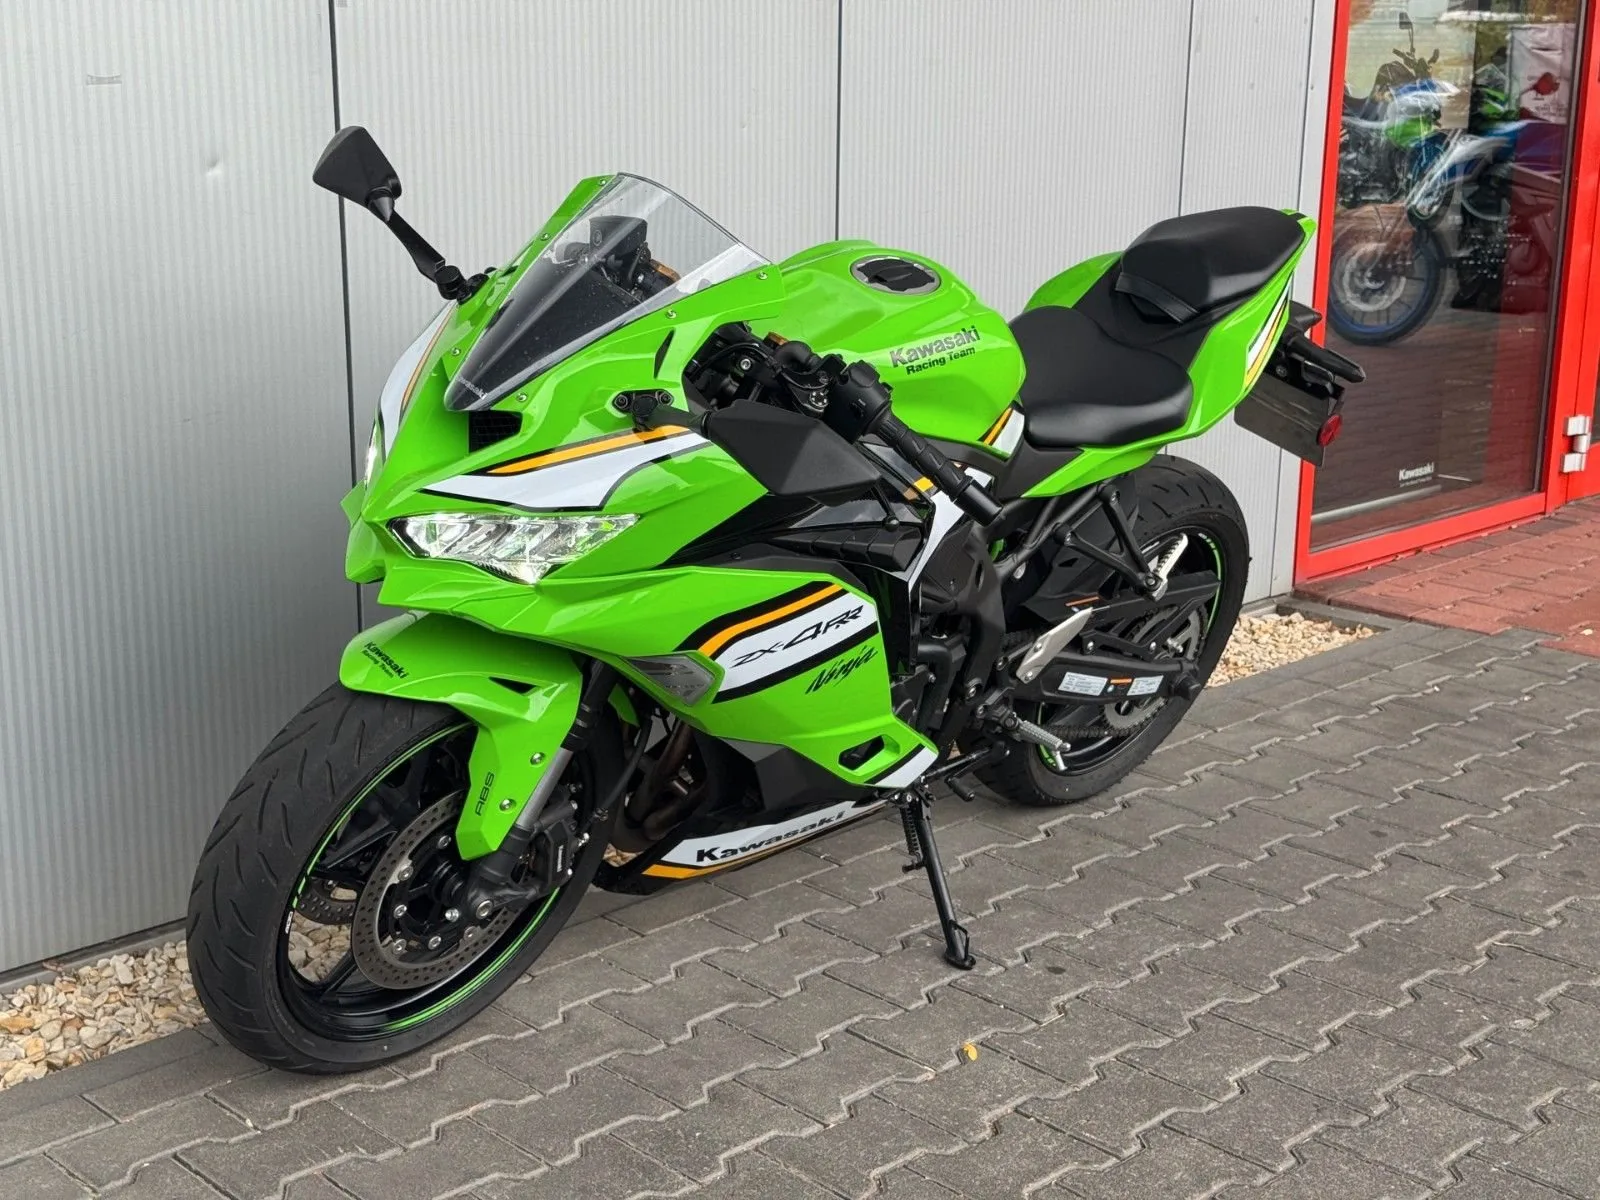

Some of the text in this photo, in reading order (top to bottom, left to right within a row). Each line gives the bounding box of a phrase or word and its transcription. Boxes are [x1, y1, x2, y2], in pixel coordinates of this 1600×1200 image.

[890, 325, 980, 368] Kawasaki
[905, 346, 975, 375] Racing Team
[364, 641, 409, 679] Kawasaki
[804, 645, 878, 694] Ninja
[475, 771, 495, 816] ABS
[696, 810, 846, 863] Kawasaki
